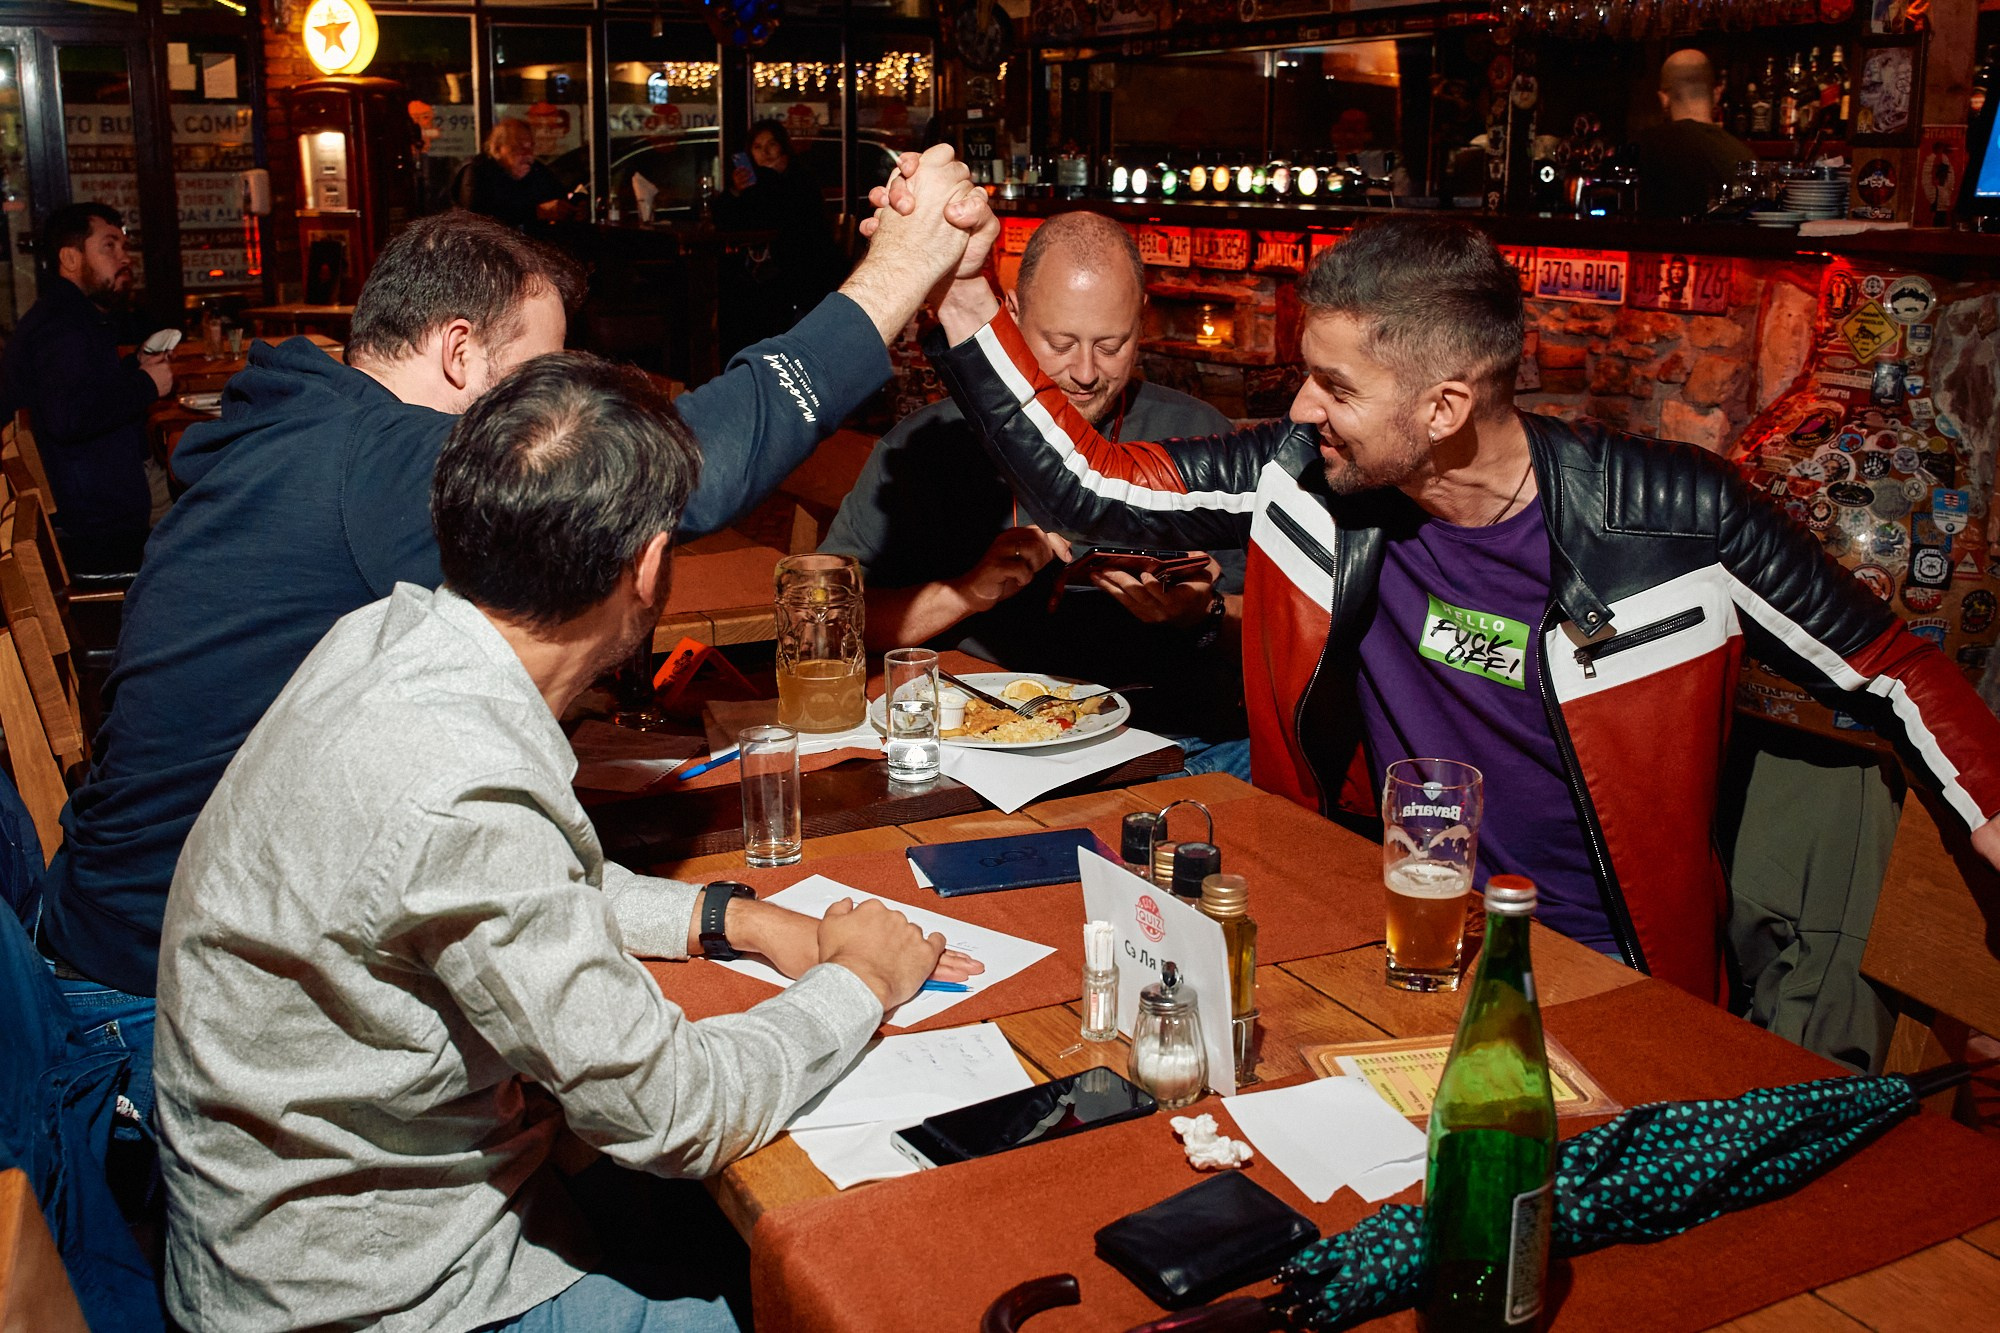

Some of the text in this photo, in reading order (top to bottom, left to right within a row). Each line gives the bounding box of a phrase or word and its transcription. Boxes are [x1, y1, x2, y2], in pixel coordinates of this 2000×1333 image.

[100, 116, 132, 134] BU
[185, 114, 248, 134] COMP
[967, 143, 992, 157] VIP
[1253, 242, 1304, 268] JAMAICA
[1540, 260, 1572, 288] 379
[1442, 604, 1505, 632] HELLO
[1430, 619, 1513, 656] FUCK
[1445, 644, 1520, 680] OFF!
[1138, 911, 1162, 930] QUIZ
[1140, 949, 1156, 970] Ля
